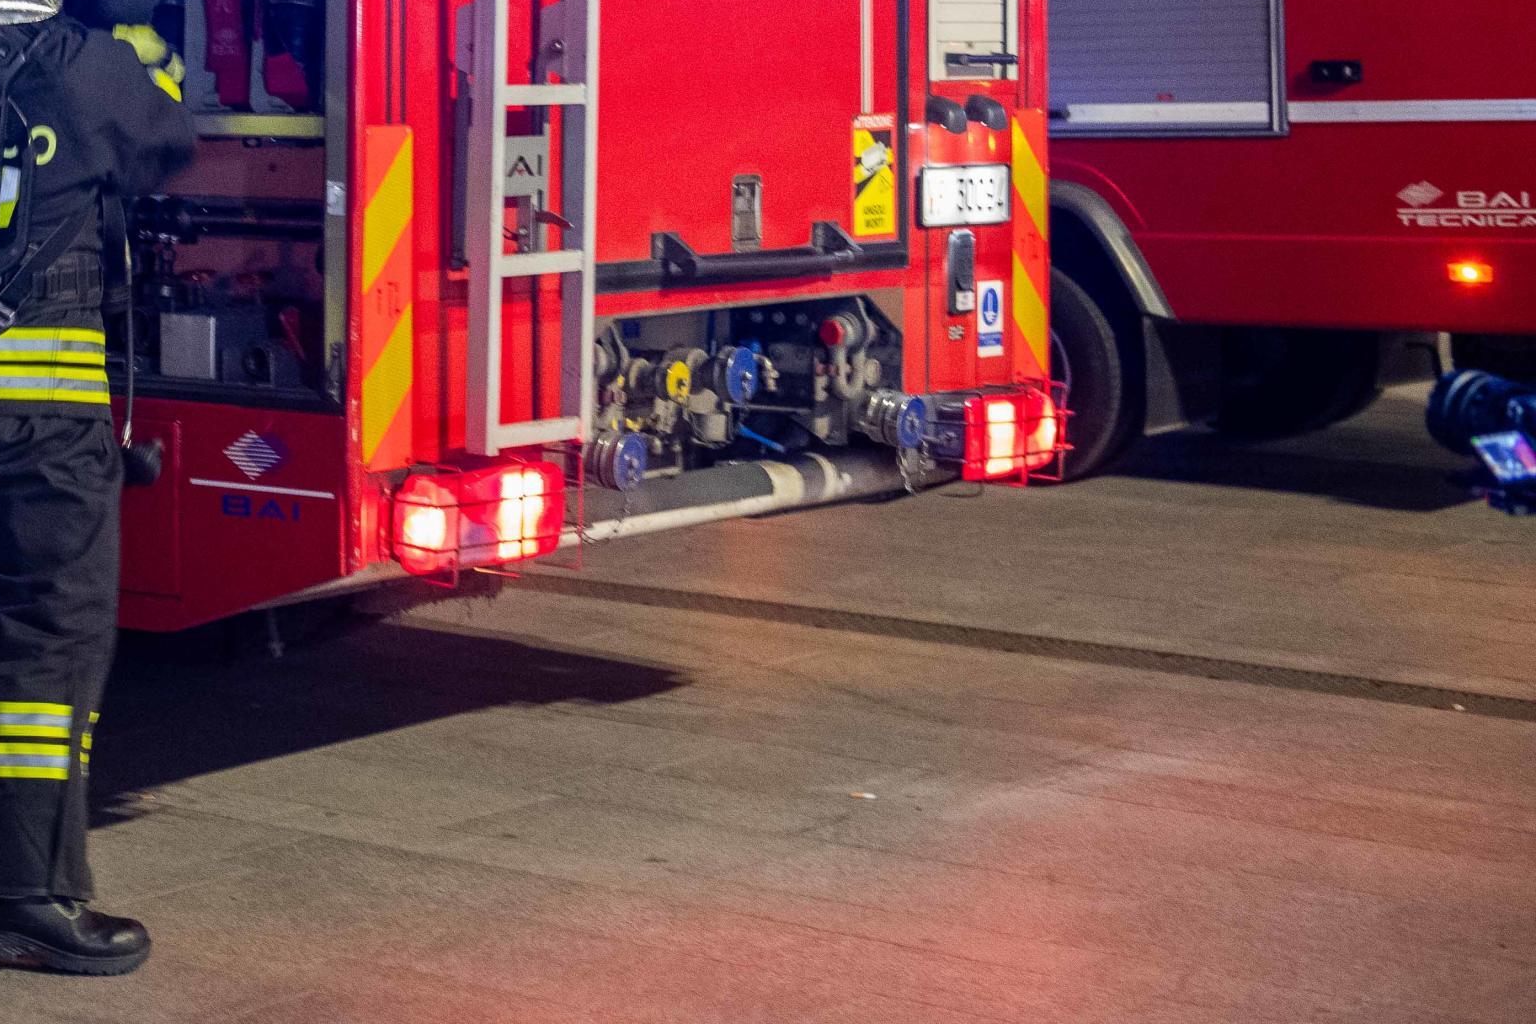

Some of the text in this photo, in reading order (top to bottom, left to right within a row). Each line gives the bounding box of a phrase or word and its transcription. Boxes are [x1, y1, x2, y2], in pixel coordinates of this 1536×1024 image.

[506, 153, 543, 178] AI
[1457, 190, 1530, 208] BAI
[221, 494, 301, 523] BAI
